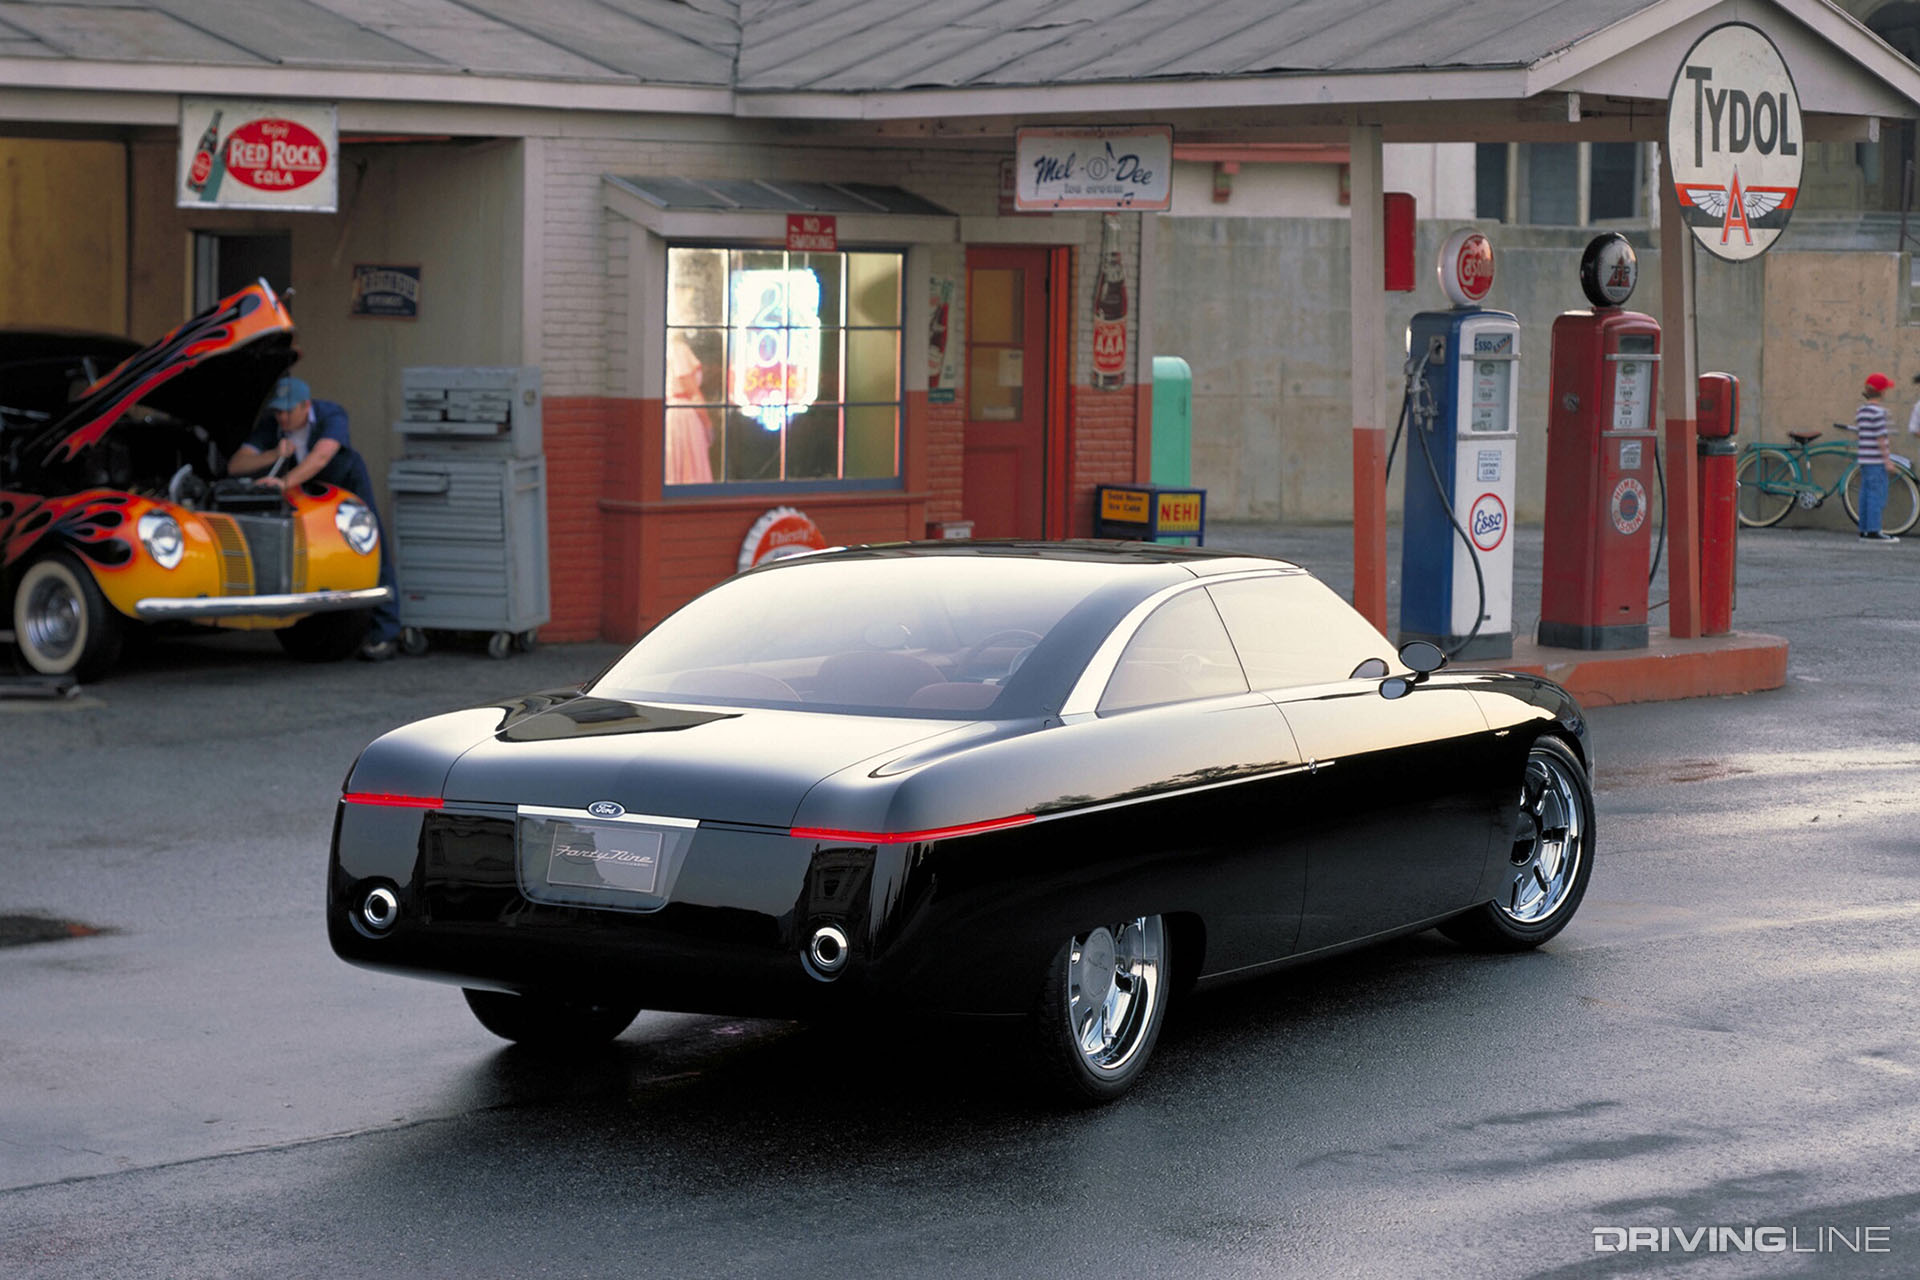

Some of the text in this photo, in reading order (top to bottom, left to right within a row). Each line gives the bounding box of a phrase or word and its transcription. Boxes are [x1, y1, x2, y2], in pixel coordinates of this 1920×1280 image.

[1686, 65, 1797, 168] TYDOL
[230, 138, 269, 168] RED
[271, 140, 322, 171] ROCK
[252, 170, 295, 185] COLA
[1116, 154, 1152, 185] Dee
[803, 217, 820, 233] NO
[790, 234, 834, 249] SMOKING
[1095, 334, 1124, 354] AAA
[1160, 503, 1199, 522] NEHI
[1474, 509, 1502, 535] Esso
[595, 804, 617, 815] Ford
